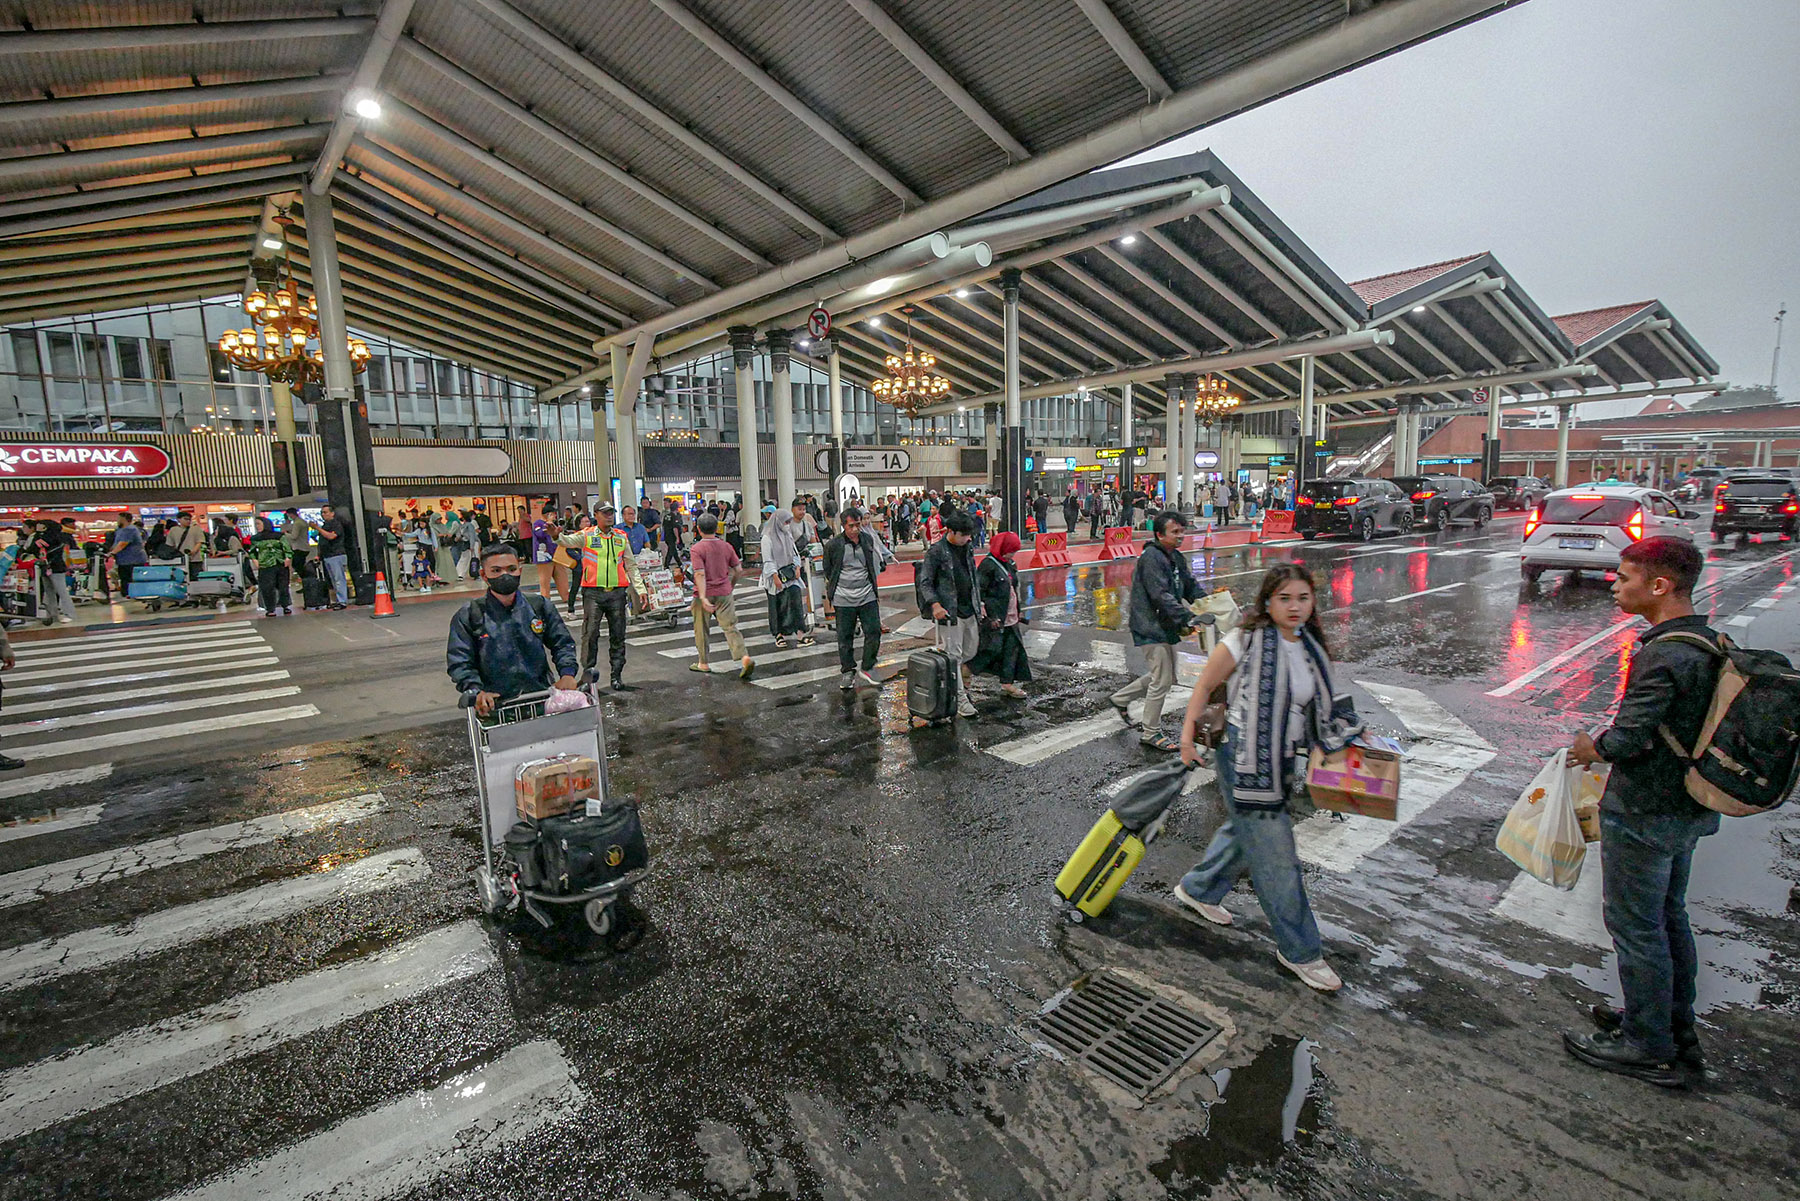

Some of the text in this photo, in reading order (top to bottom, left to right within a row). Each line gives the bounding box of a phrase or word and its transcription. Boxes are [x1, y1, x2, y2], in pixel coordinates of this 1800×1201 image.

[21, 448, 140, 464] CEMPAKA
[1136, 447, 1146, 456] 1A
[881, 453, 902, 469] 1A
[97, 465, 136, 474] RESTO
[841, 486, 858, 500] 1A
